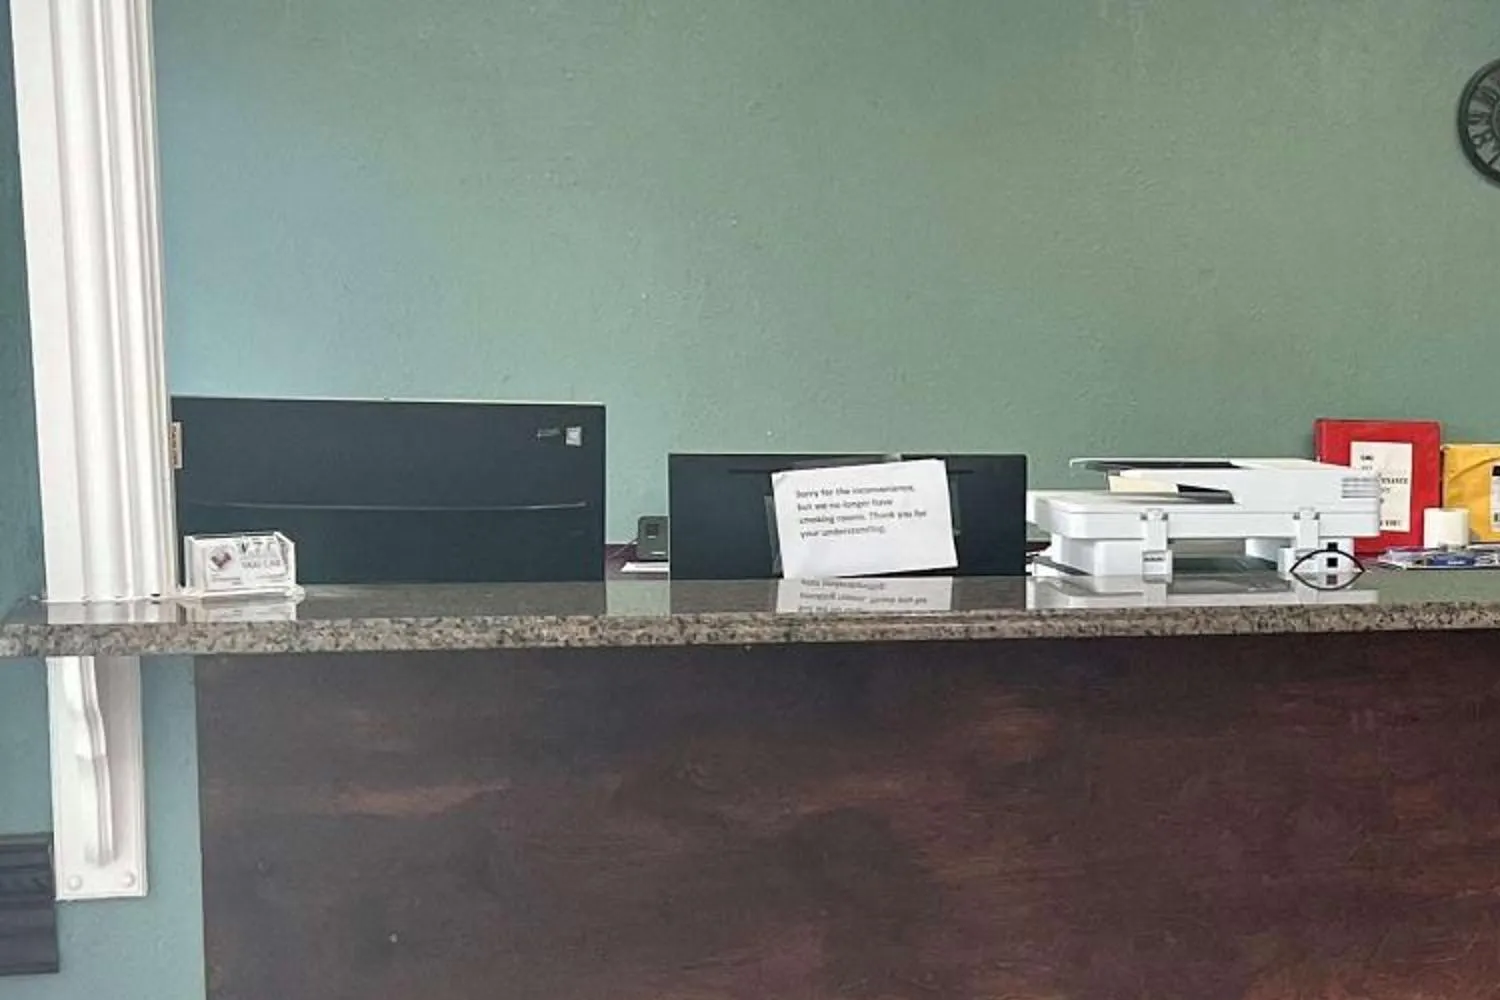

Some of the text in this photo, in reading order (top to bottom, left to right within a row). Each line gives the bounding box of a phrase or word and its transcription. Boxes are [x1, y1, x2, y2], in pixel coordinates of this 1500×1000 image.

[796, 489, 818, 498] Sorry
[820, 487, 833, 496] for
[836, 486, 850, 496] the
[797, 502, 812, 511] but
[842, 500, 870, 509] longer
[872, 498, 893, 507] have
[869, 510, 895, 521] Thank
[913, 508, 926, 517] for
